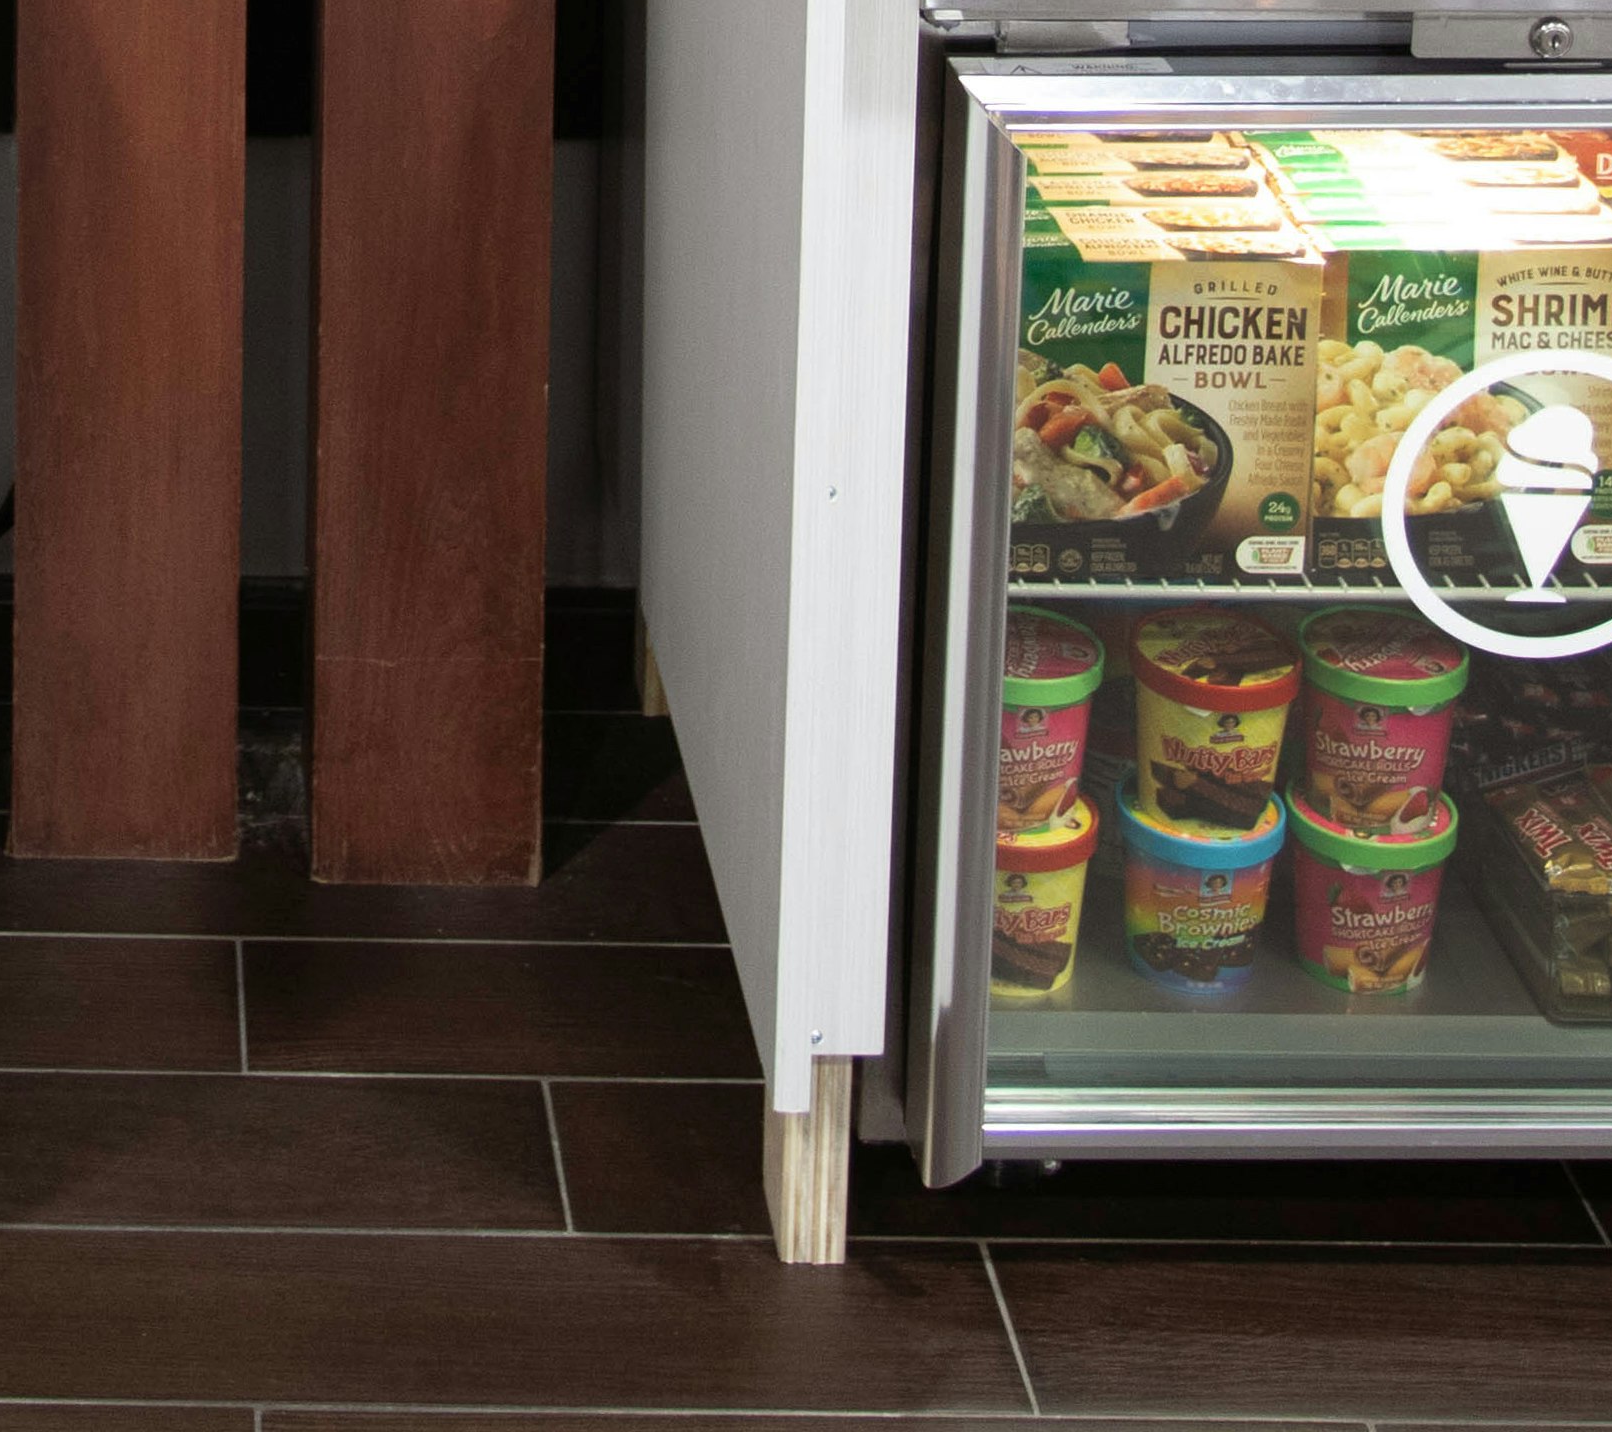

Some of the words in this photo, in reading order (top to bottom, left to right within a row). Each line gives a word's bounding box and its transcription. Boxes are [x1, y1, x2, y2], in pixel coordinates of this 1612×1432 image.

[1496, 271, 1533, 287] WHITE
[1538, 266, 1569, 279] WINE
[1571, 265, 1581, 277] &
[1193, 282, 1278, 296] GRILLED
[1357, 274, 1463, 312] Marie
[1028, 287, 1134, 322] Marie
[1027, 312, 1141, 347] Callender's
[1158, 305, 1308, 341] CHICKEN
[1356, 300, 1469, 336] Callender's
[1158, 345, 1248, 366] ALFREDO
[1252, 345, 1305, 366] BAKE
[1194, 372, 1267, 389] BOWL
[1315, 730, 1426, 767] Strawberry
[1172, 903, 1251, 920] Cosmic
[1331, 904, 1434, 927] Strawberry
[1158, 912, 1260, 936] Brownies
